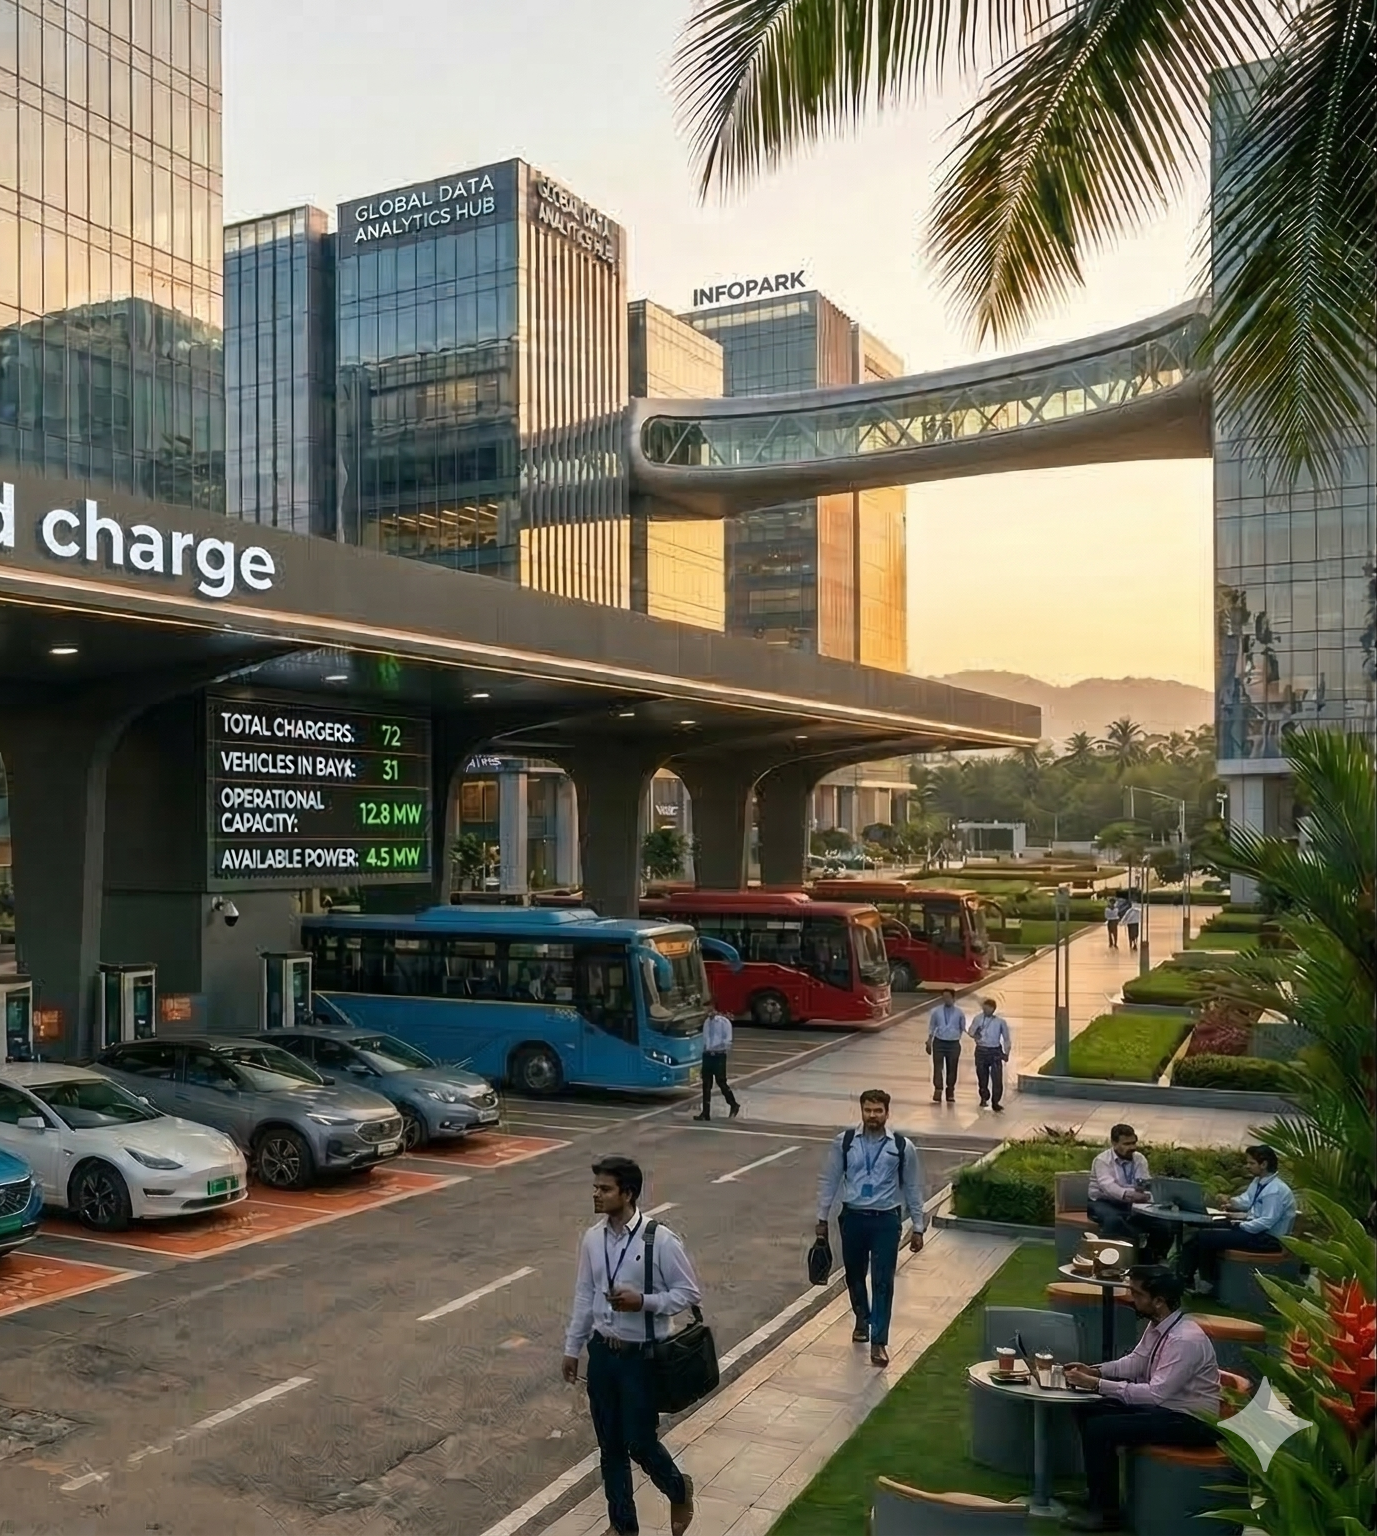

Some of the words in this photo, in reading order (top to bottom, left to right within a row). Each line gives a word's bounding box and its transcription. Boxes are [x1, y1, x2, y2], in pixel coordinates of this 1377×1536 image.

[355, 191, 433, 223] GLOBAL
[439, 174, 494, 202] DATA
[354, 207, 451, 243] ANALYTICS
[455, 195, 495, 221] HUB
[693, 270, 806, 307] INFOPARK
[41, 499, 277, 598] charge
[221, 713, 271, 736] TOTAL
[382, 725, 401, 747] 72
[221, 751, 294, 774] VEHICLES
[298, 755, 313, 775] IN
[382, 760, 398, 781] 31
[221, 787, 325, 809] OPERATIONAL
[221, 813, 299, 833] CAPACITY:
[360, 802, 390, 825] 12.8
[394, 804, 422, 825] MW
[221, 848, 302, 869] AVAILABLE
[305, 849, 359, 868] POWER:
[366, 847, 390, 867] 4.5
[394, 847, 420, 867] MW
